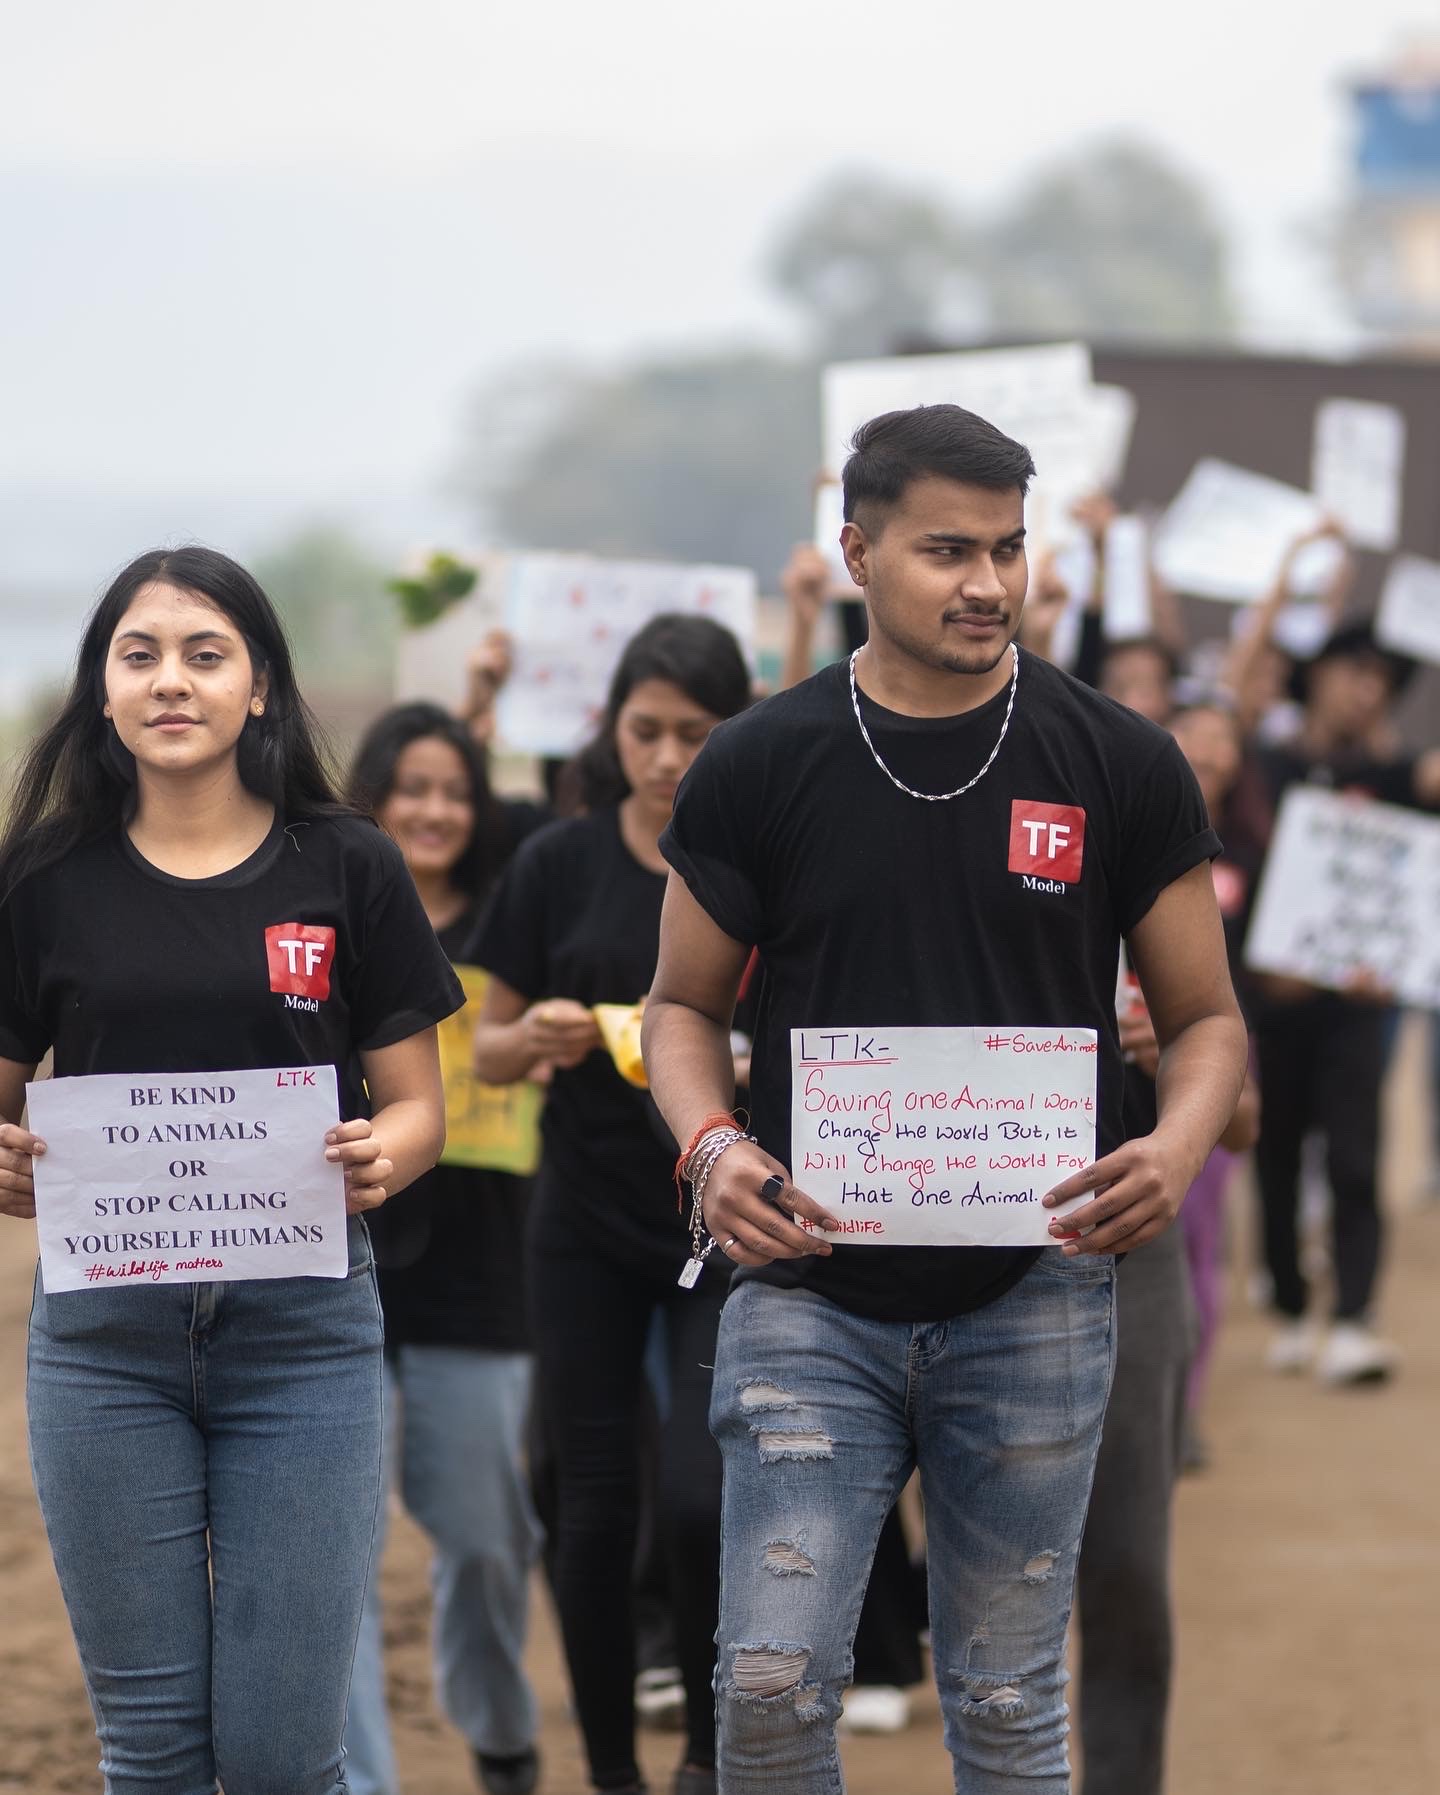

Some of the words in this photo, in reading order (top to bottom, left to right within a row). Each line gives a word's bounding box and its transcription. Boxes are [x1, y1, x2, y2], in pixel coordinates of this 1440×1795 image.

[1022, 820, 1070, 859] TF
[1022, 875, 1065, 894] Model
[278, 940, 325, 976] TF
[284, 994, 319, 1012] Model
[276, 1070, 317, 1087] LTK
[130, 1087, 163, 1106] BE
[171, 1085, 236, 1105] KIND
[804, 1068, 892, 1133] Saving
[904, 1091, 947, 1111] one
[951, 1085, 1034, 1111] Animal
[102, 1125, 139, 1144] TO
[147, 1121, 268, 1144] ANIMALS
[168, 1160, 208, 1178] OR
[94, 1196, 160, 1217] STOP
[168, 1191, 288, 1212] CALLING
[961, 1181, 1038, 1207] Animal.
[63, 1230, 202, 1255] YOURSELF
[210, 1225, 323, 1248] HUMANS
[176, 1257, 223, 1271] matters
